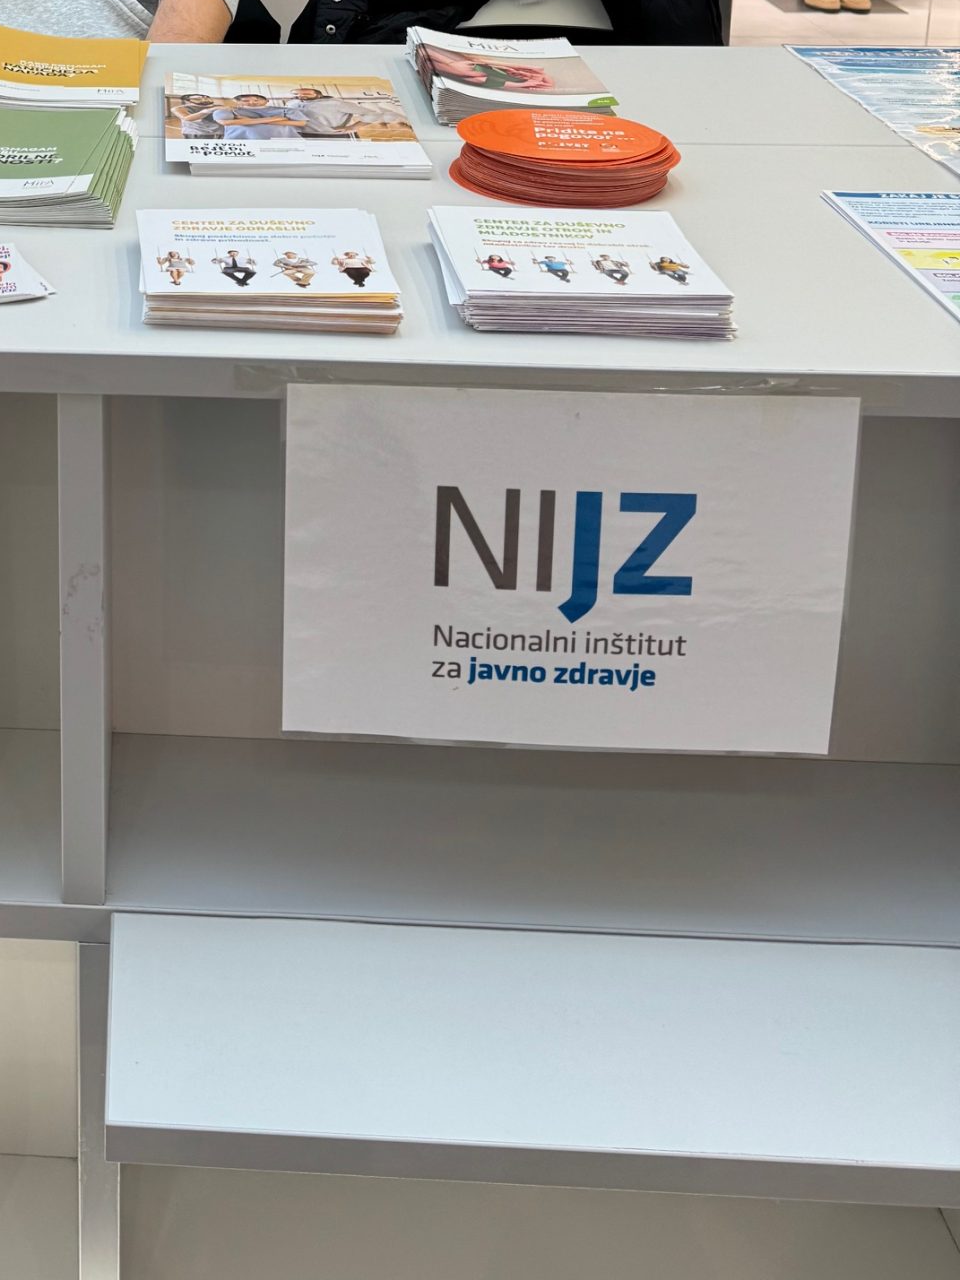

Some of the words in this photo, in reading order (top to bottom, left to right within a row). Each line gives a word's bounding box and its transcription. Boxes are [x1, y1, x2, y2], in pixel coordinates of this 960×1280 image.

[434, 485, 697, 623] NIJZ
[433, 624, 576, 654] Nacionalni
[585, 631, 687, 657] inštitut
[432, 660, 462, 678] za
[467, 656, 546, 685] javno
[553, 662, 656, 692] zdravje
